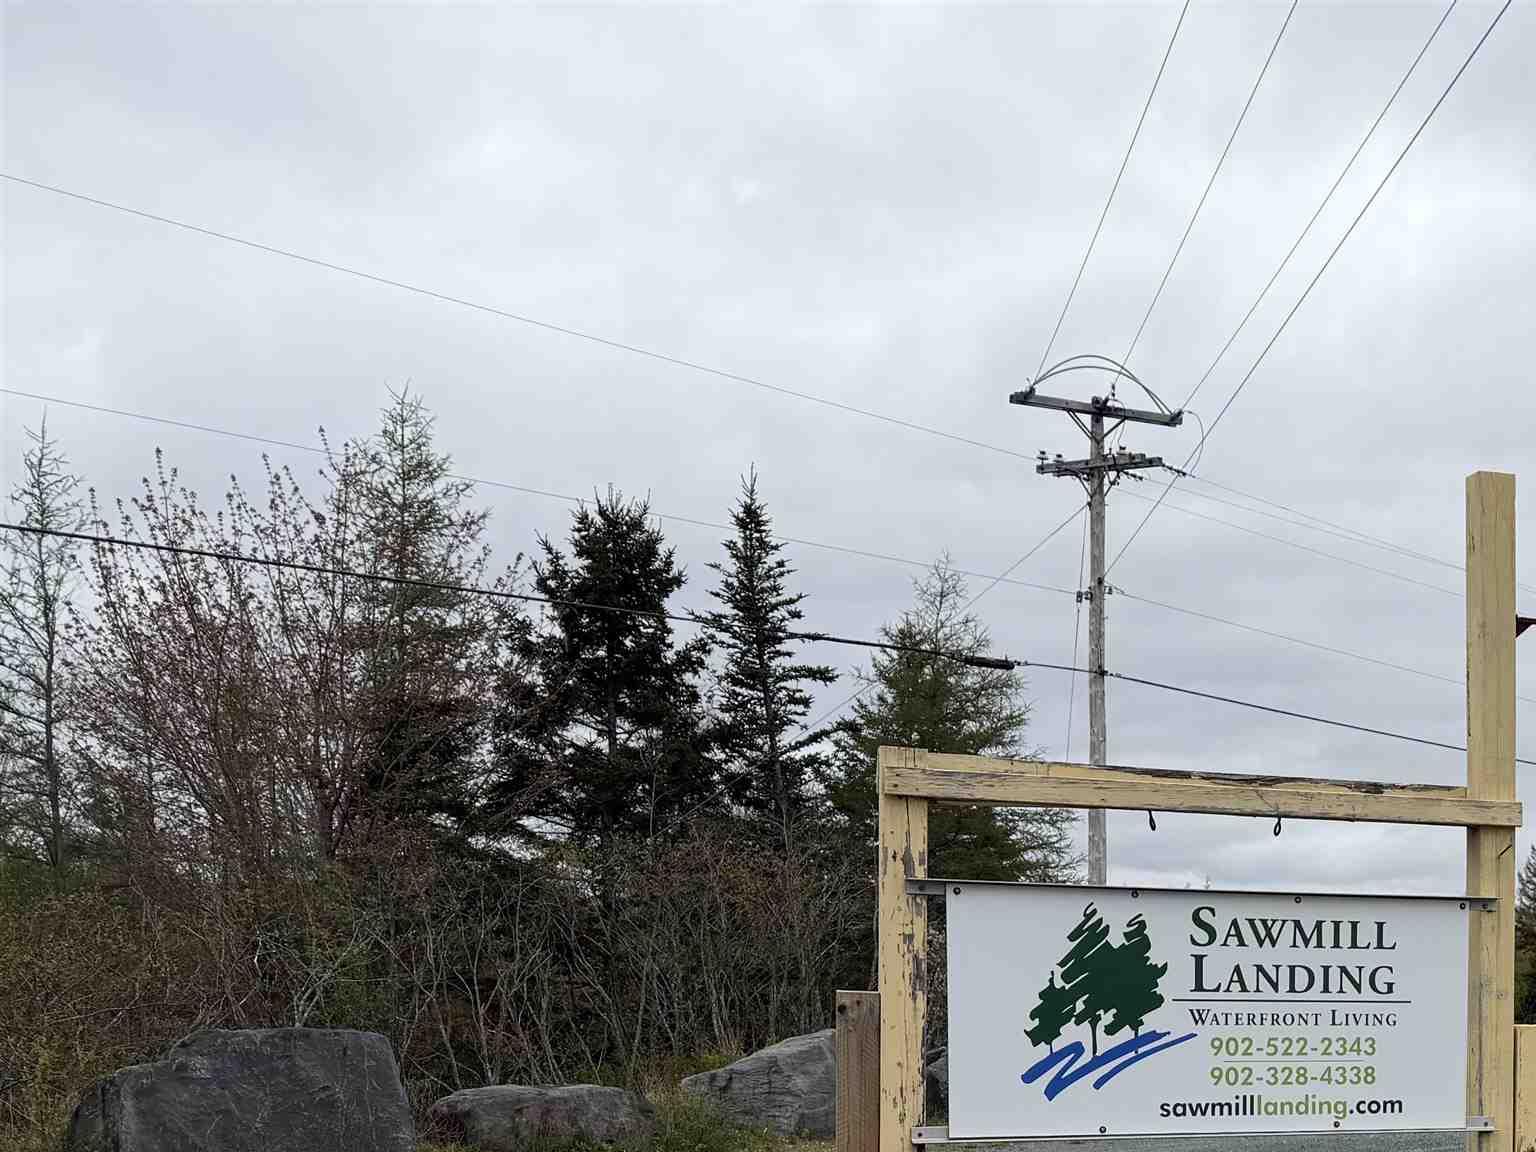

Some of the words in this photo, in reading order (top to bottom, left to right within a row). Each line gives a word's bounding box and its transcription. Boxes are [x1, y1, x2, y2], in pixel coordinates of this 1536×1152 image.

[1189, 905, 1397, 950] SAWMILL
[1189, 953, 1396, 995] LANDING
[1188, 1008, 1322, 1027] WATERFRONT
[1329, 1009, 1397, 1027] LIVING
[1209, 1036, 1377, 1057] 902-522-2343
[1209, 1065, 1377, 1087] 902-328-4338
[1159, 1094, 1403, 1120] sawmilllanding.com
